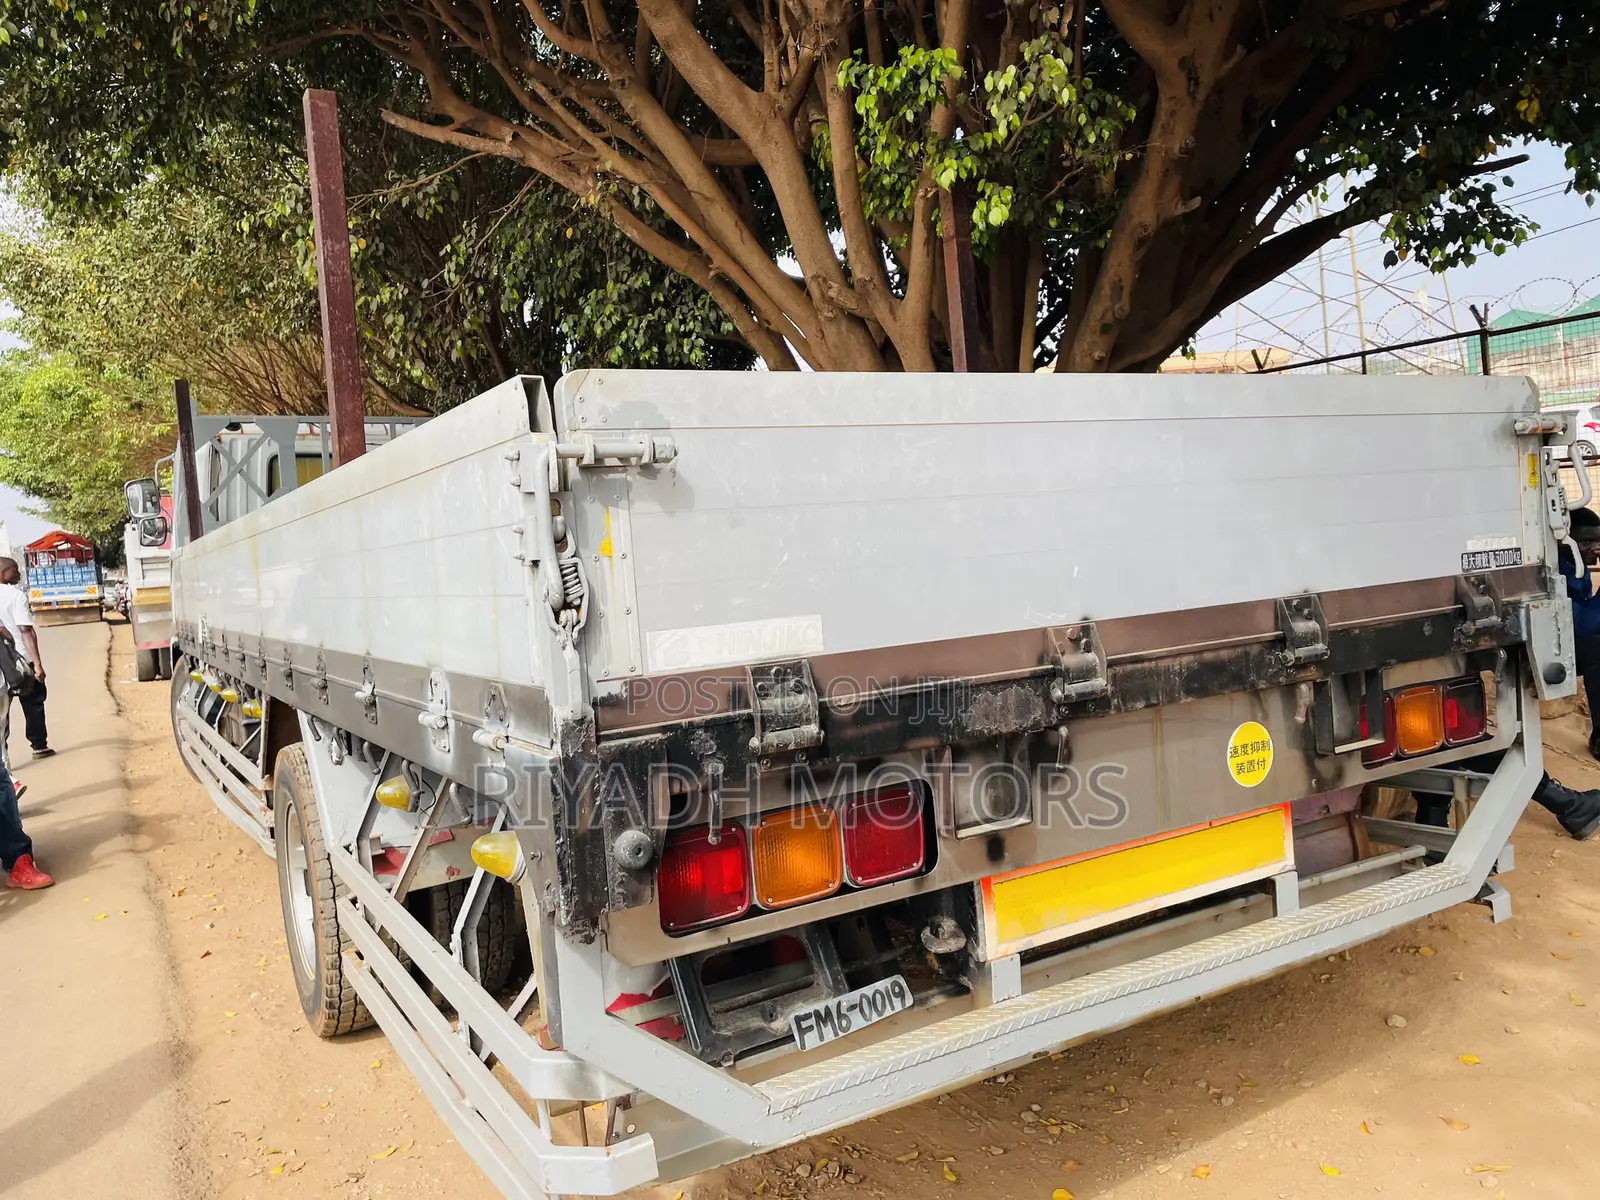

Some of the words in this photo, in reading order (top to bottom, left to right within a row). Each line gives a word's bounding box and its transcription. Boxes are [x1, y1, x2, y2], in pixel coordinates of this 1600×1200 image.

[1229, 739, 1271, 759] 速度抑制
[1235, 757, 1267, 776] 装置付
[793, 979, 907, 1051] FM6-0019
